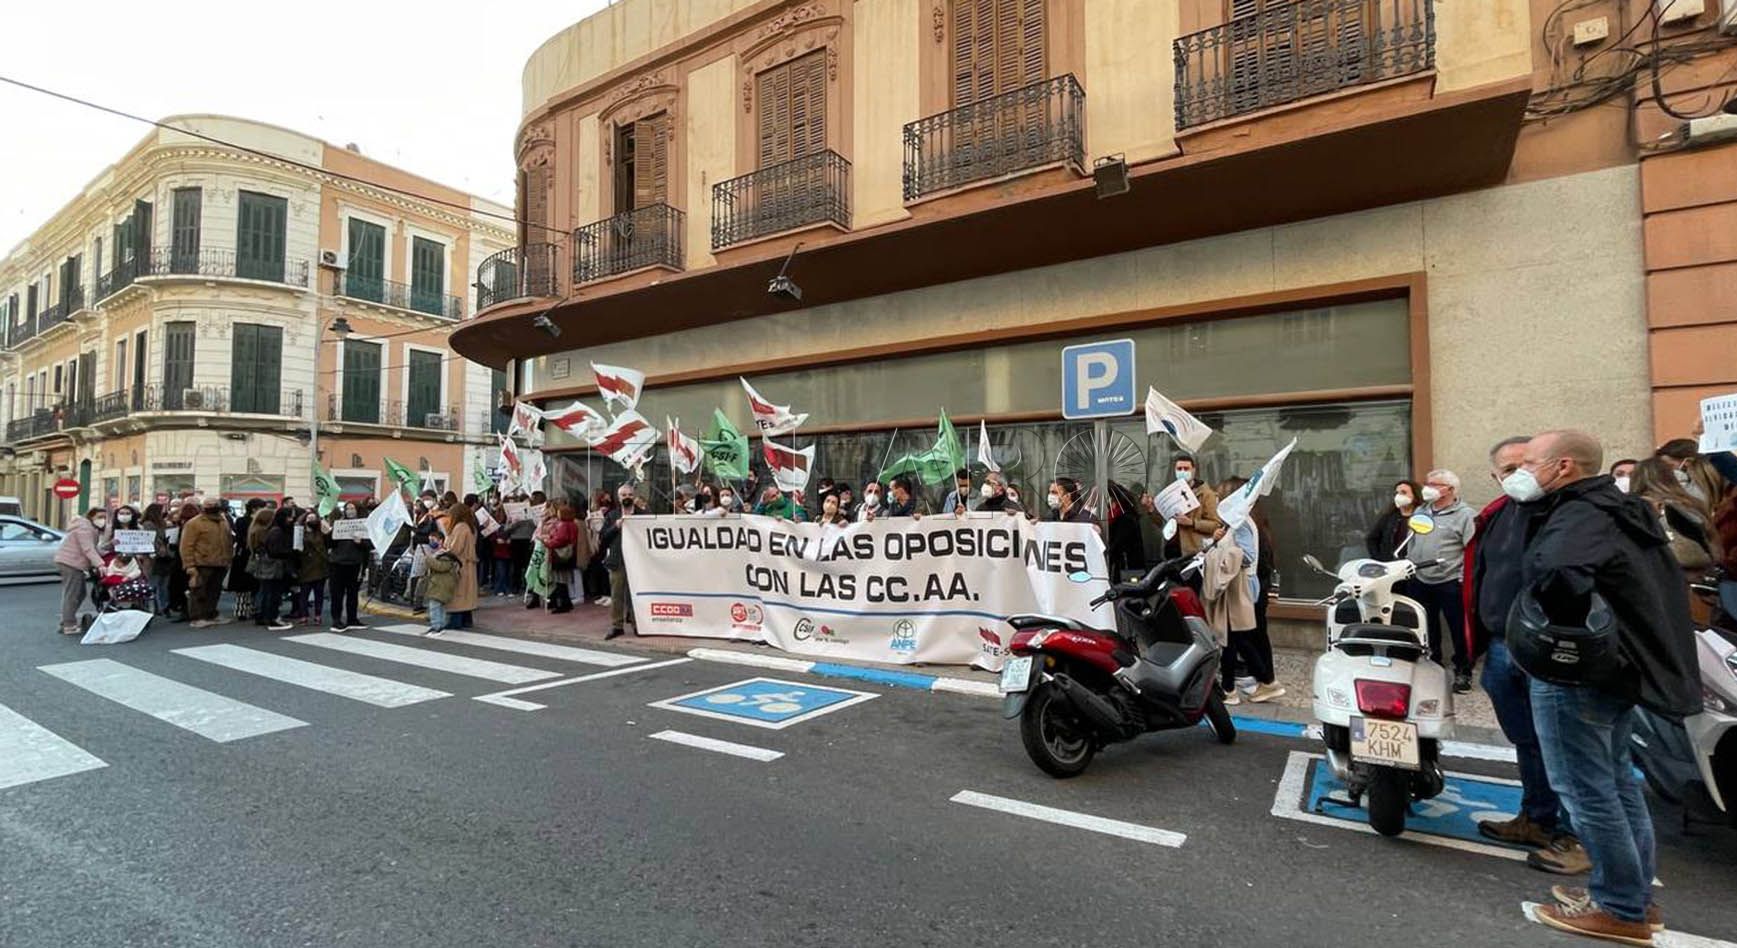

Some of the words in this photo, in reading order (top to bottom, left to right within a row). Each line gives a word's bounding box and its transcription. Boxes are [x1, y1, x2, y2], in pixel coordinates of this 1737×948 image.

[1077, 352, 1118, 409] P
[646, 527, 761, 552] IGUALDAD
[769, 531, 808, 559] EN
[816, 535, 874, 562] LAS
[885, 528, 1088, 573] OPOSICINES
[746, 564, 788, 594] CON
[801, 572, 856, 600] LAS
[866, 572, 979, 602] CC.AA.
[1368, 722, 1412, 742] 7524
[1368, 739, 1402, 758] KHM
